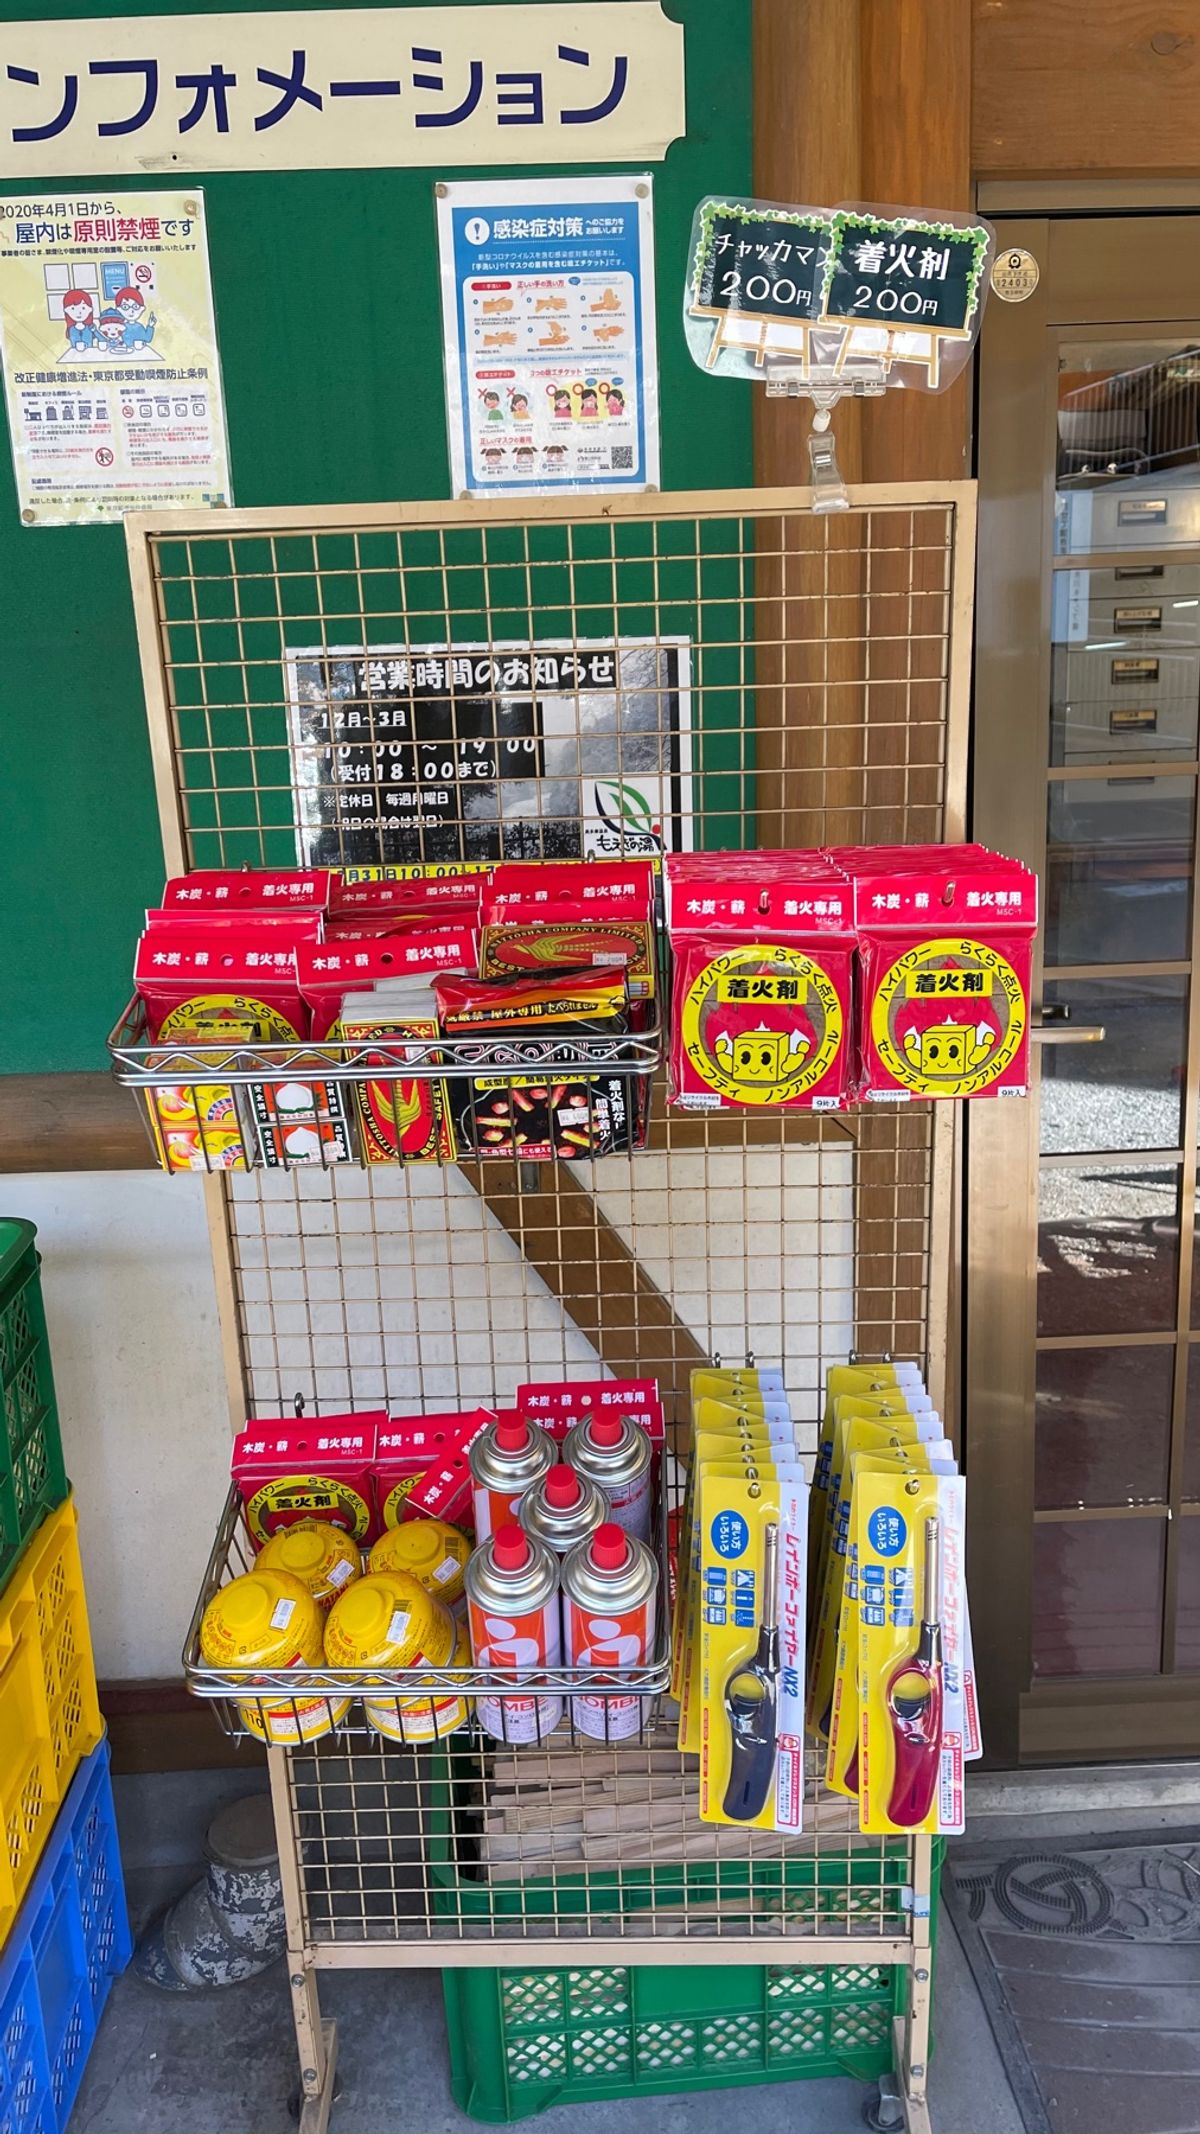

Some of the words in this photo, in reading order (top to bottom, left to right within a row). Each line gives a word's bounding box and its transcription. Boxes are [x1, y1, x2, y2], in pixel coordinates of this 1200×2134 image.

[7, 45, 628, 142] ンフォメーション
[16, 217, 194, 244] 屋内は原則禁煙です
[493, 217, 583, 240] 感染症対策
[855, 240, 951, 281] 着火剤
[720, 271, 812, 306] 200円
[853, 285, 937, 316] 200円
[358, 656, 614, 692] 営業時間のお知らせ
[262, 882, 314, 897] 着火専用
[425, 884, 476, 896] 着火専用
[583, 884, 636, 898] 着火専用
[966, 891, 1022, 907] 着火専用
[784, 899, 843, 915] 着火専用
[601, 927, 643, 945] LIMITED
[405, 944, 461, 962] 着火専用
[690, 952, 744, 1005] ハイパワー
[774, 948, 837, 1014] らくらく点火
[878, 947, 932, 1002] ハイパワー
[915, 973, 984, 993] 着火剤
[959, 941, 1021, 1004] らくらく点火
[727, 979, 798, 999] 着火剤
[234, 997, 296, 1042] らくらく点
[686, 1042, 740, 1098] セーフティ
[765, 1030, 840, 1103] ノンアルコール
[877, 1038, 930, 1092] セーフティ
[953, 1020, 1022, 1095] ノンアルコール
[601, 1391, 645, 1404] 着火専用
[317, 1436, 363, 1450] 着火専用
[275, 1494, 331, 1509] 着火剤
[720, 1516, 731, 1553] いろいろ
[731, 1521, 742, 1550] 使い方
[876, 1512, 887, 1550] いろいろ
[889, 1517, 900, 1547] 使い方
